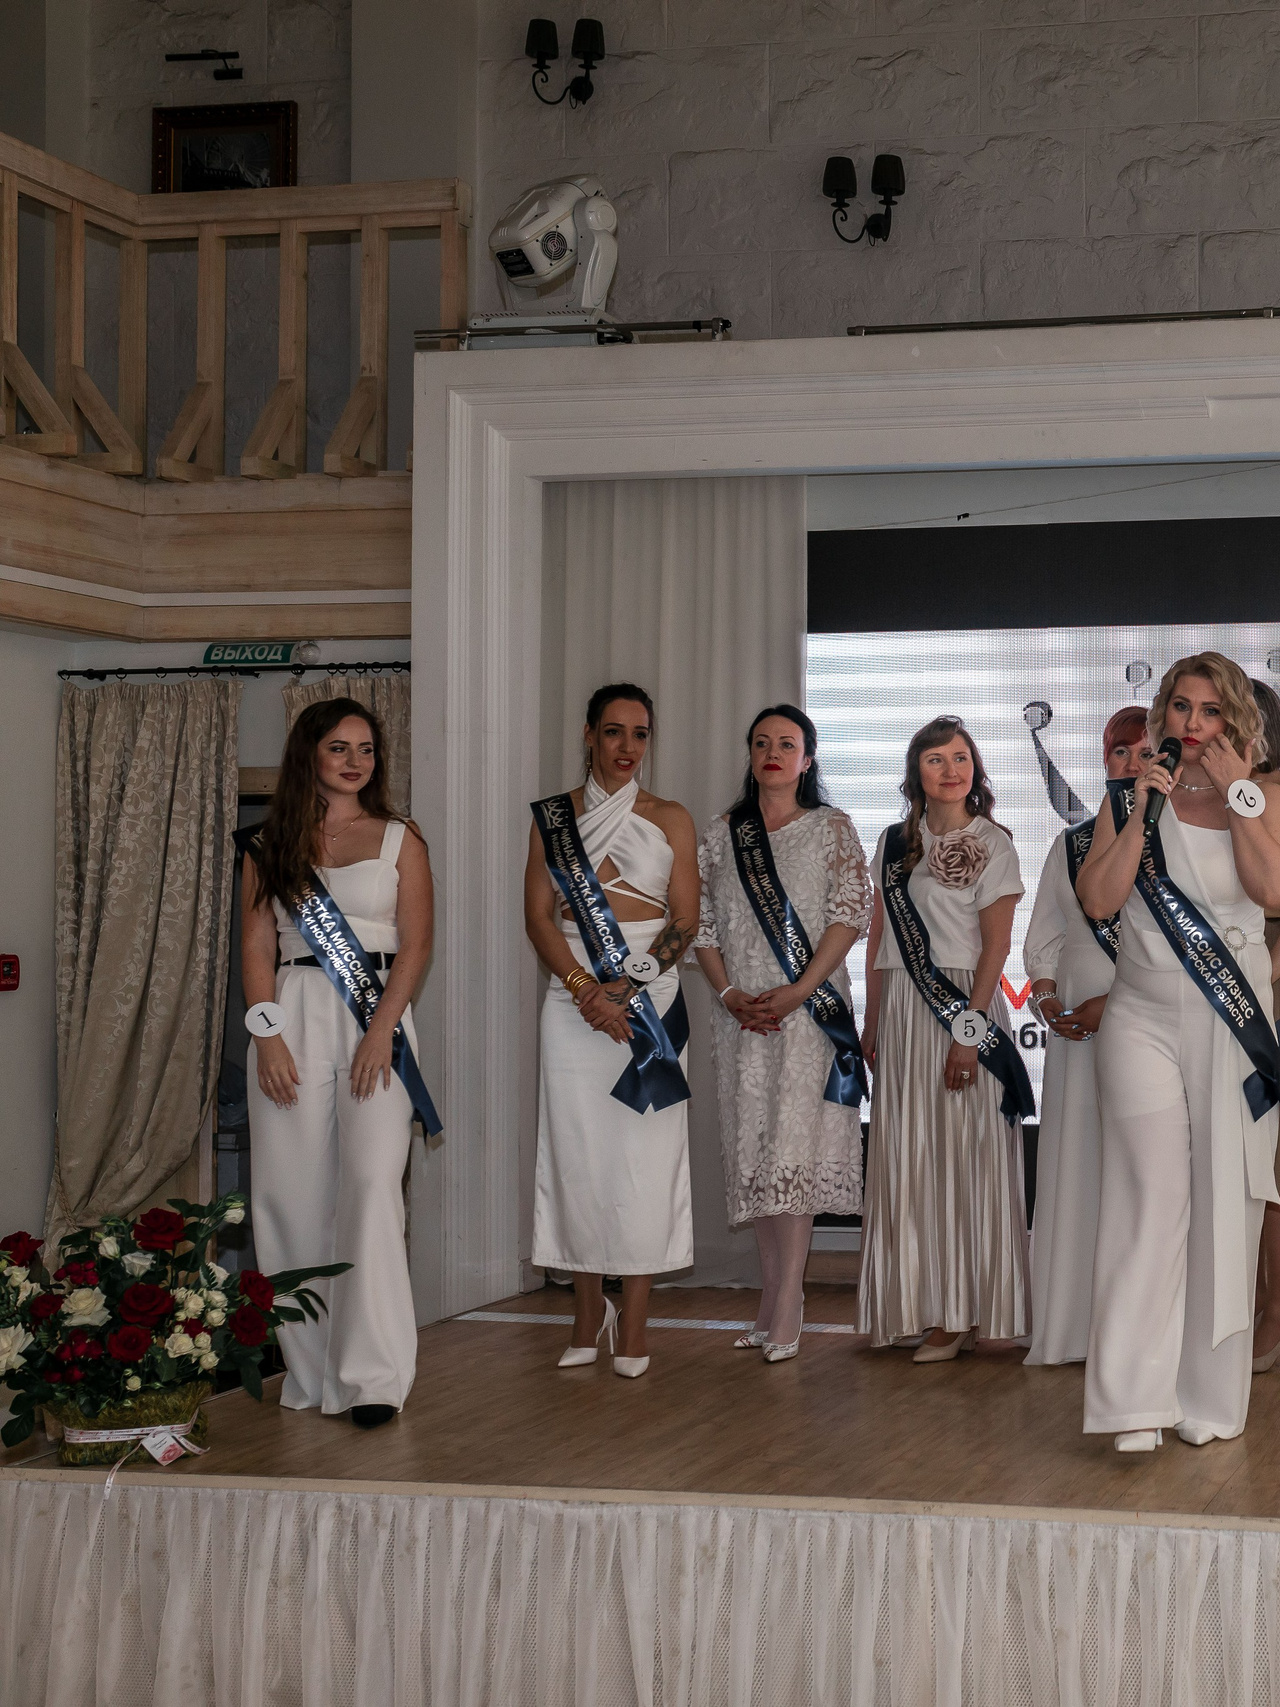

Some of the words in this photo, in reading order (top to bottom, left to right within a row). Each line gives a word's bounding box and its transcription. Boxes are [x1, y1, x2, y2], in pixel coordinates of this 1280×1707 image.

[211, 645, 284, 661] ВЫХОД
[1236, 788, 1257, 808] 2
[741, 851, 767, 906] НОВОСИБИРСК
[762, 906, 770, 914] И
[766, 913, 802, 976] НОВОСИБИРСК
[752, 848, 786, 921] ФИНАЛИСТКА
[589, 906, 622, 963] МИССИС
[889, 892, 914, 954] НОВОСИБИРСК
[895, 887, 925, 969] ФИНАЛИСТКА
[921, 967, 961, 1012] МИССИС
[306, 916, 315, 926] И
[311, 923, 363, 1004] НОВОСИБИРСКАЯ
[330, 931, 371, 988] МИССИС
[632, 961, 651, 973] 3
[909, 953, 917, 961] И
[1158, 904, 1217, 987] НОВОСИБИРСКАЯ
[1213, 985, 1245, 1028] ОБЛАСТЬ
[1175, 910, 1222, 969] МИССИС
[1217, 967, 1254, 1019] БИЗНЕС
[257, 1010, 277, 1030] 1
[911, 960, 955, 1024] НОВОСИБИРСКА
[963, 1018, 976, 1038] 5
